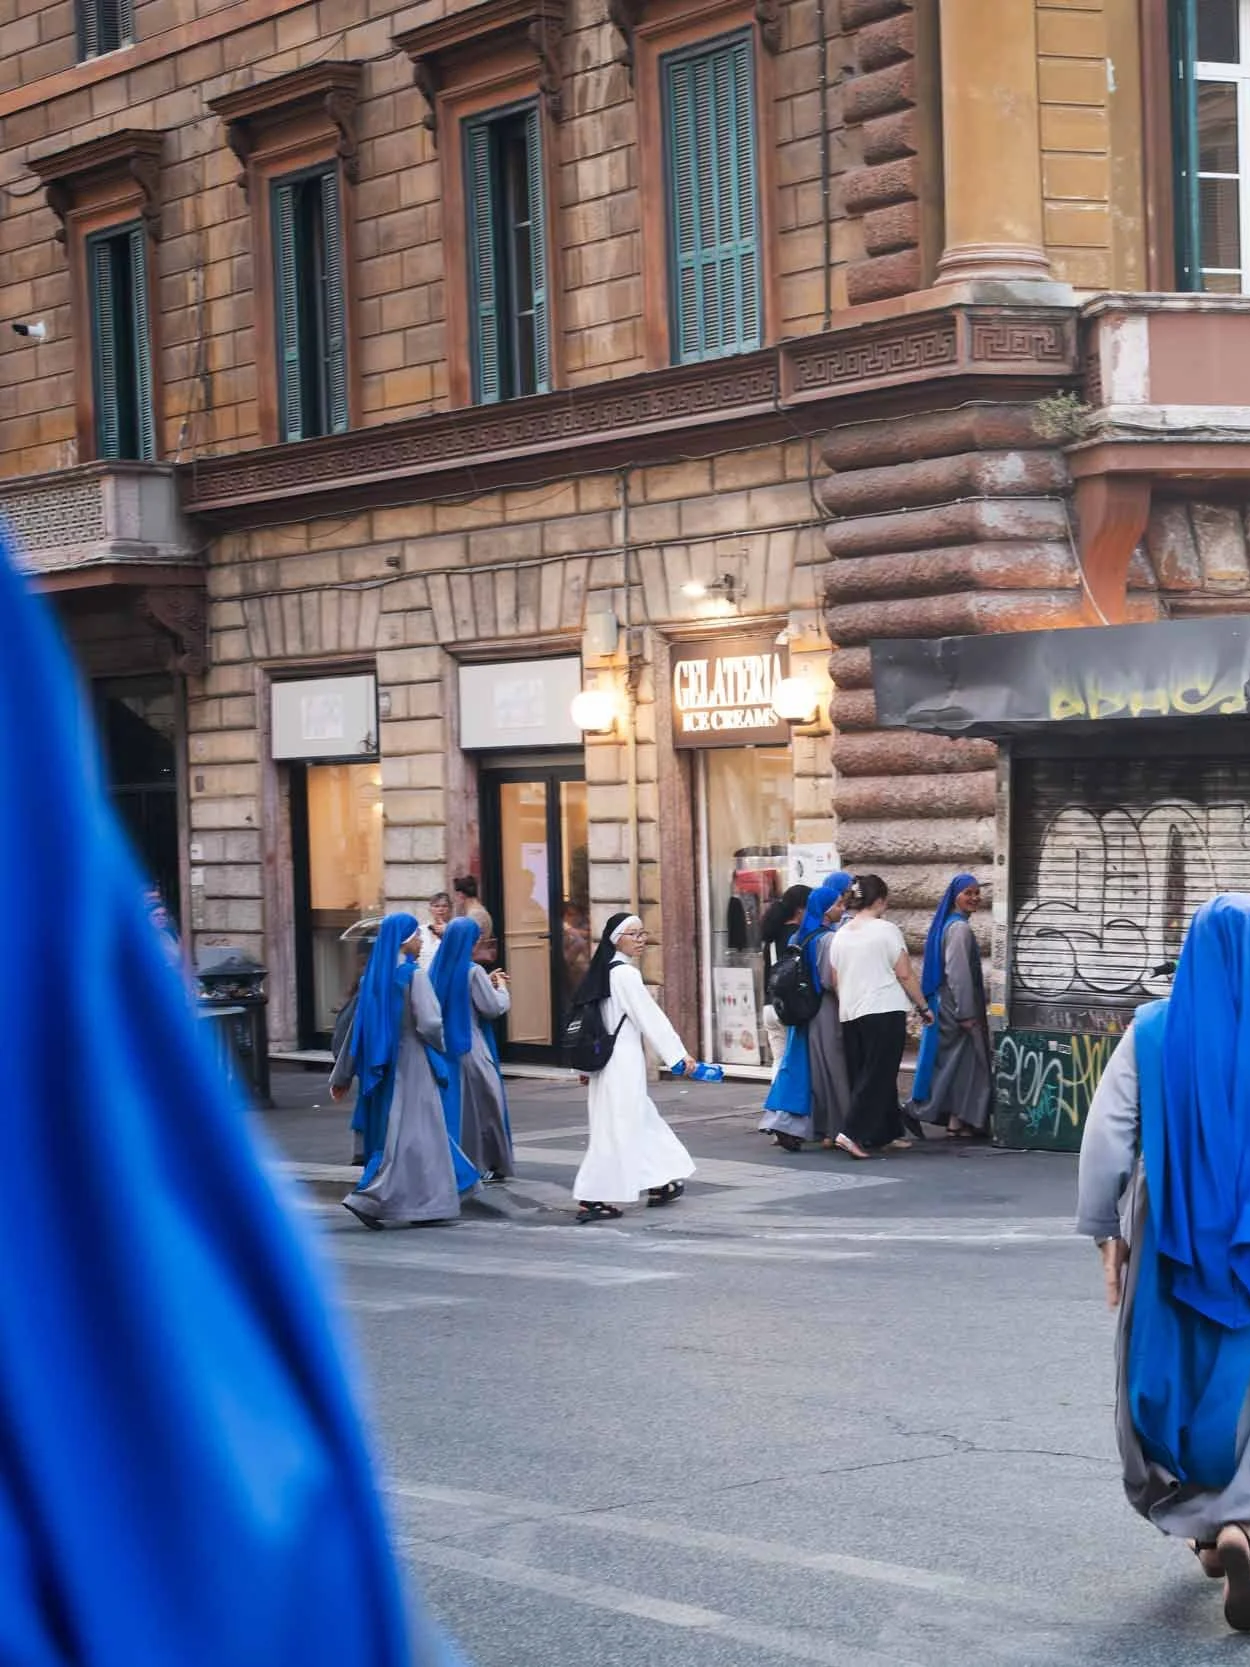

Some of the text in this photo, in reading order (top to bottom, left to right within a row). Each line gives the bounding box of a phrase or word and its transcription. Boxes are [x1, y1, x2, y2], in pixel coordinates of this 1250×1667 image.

[674, 653, 784, 710] GELATERIA
[682, 708, 779, 731] ICE CREAMS
